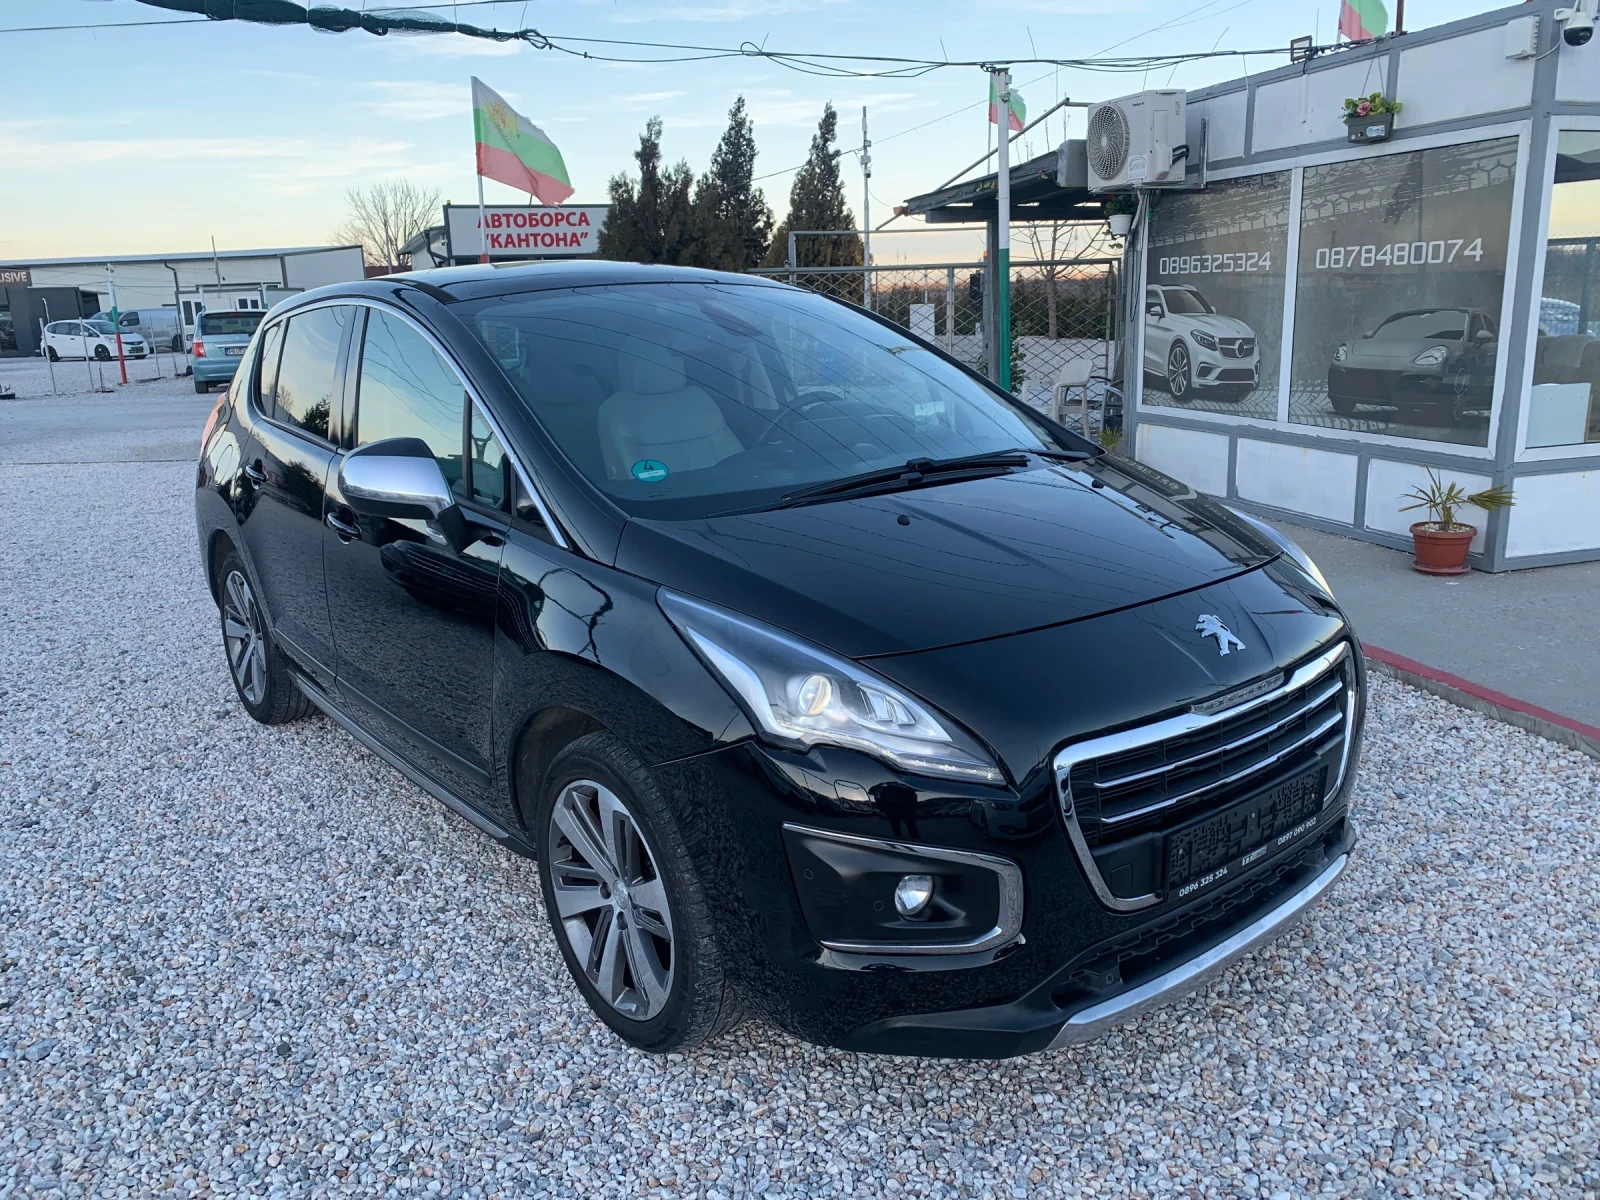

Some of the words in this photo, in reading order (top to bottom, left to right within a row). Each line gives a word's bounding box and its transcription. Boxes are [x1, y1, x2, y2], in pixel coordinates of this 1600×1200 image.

[477, 211, 591, 229] АВТОБОРСА
[1159, 251, 1272, 275] 0896325324
[1315, 237, 1484, 269] 0878480074
[1179, 881, 1199, 897] 0896
[1200, 873, 1214, 887] 325
